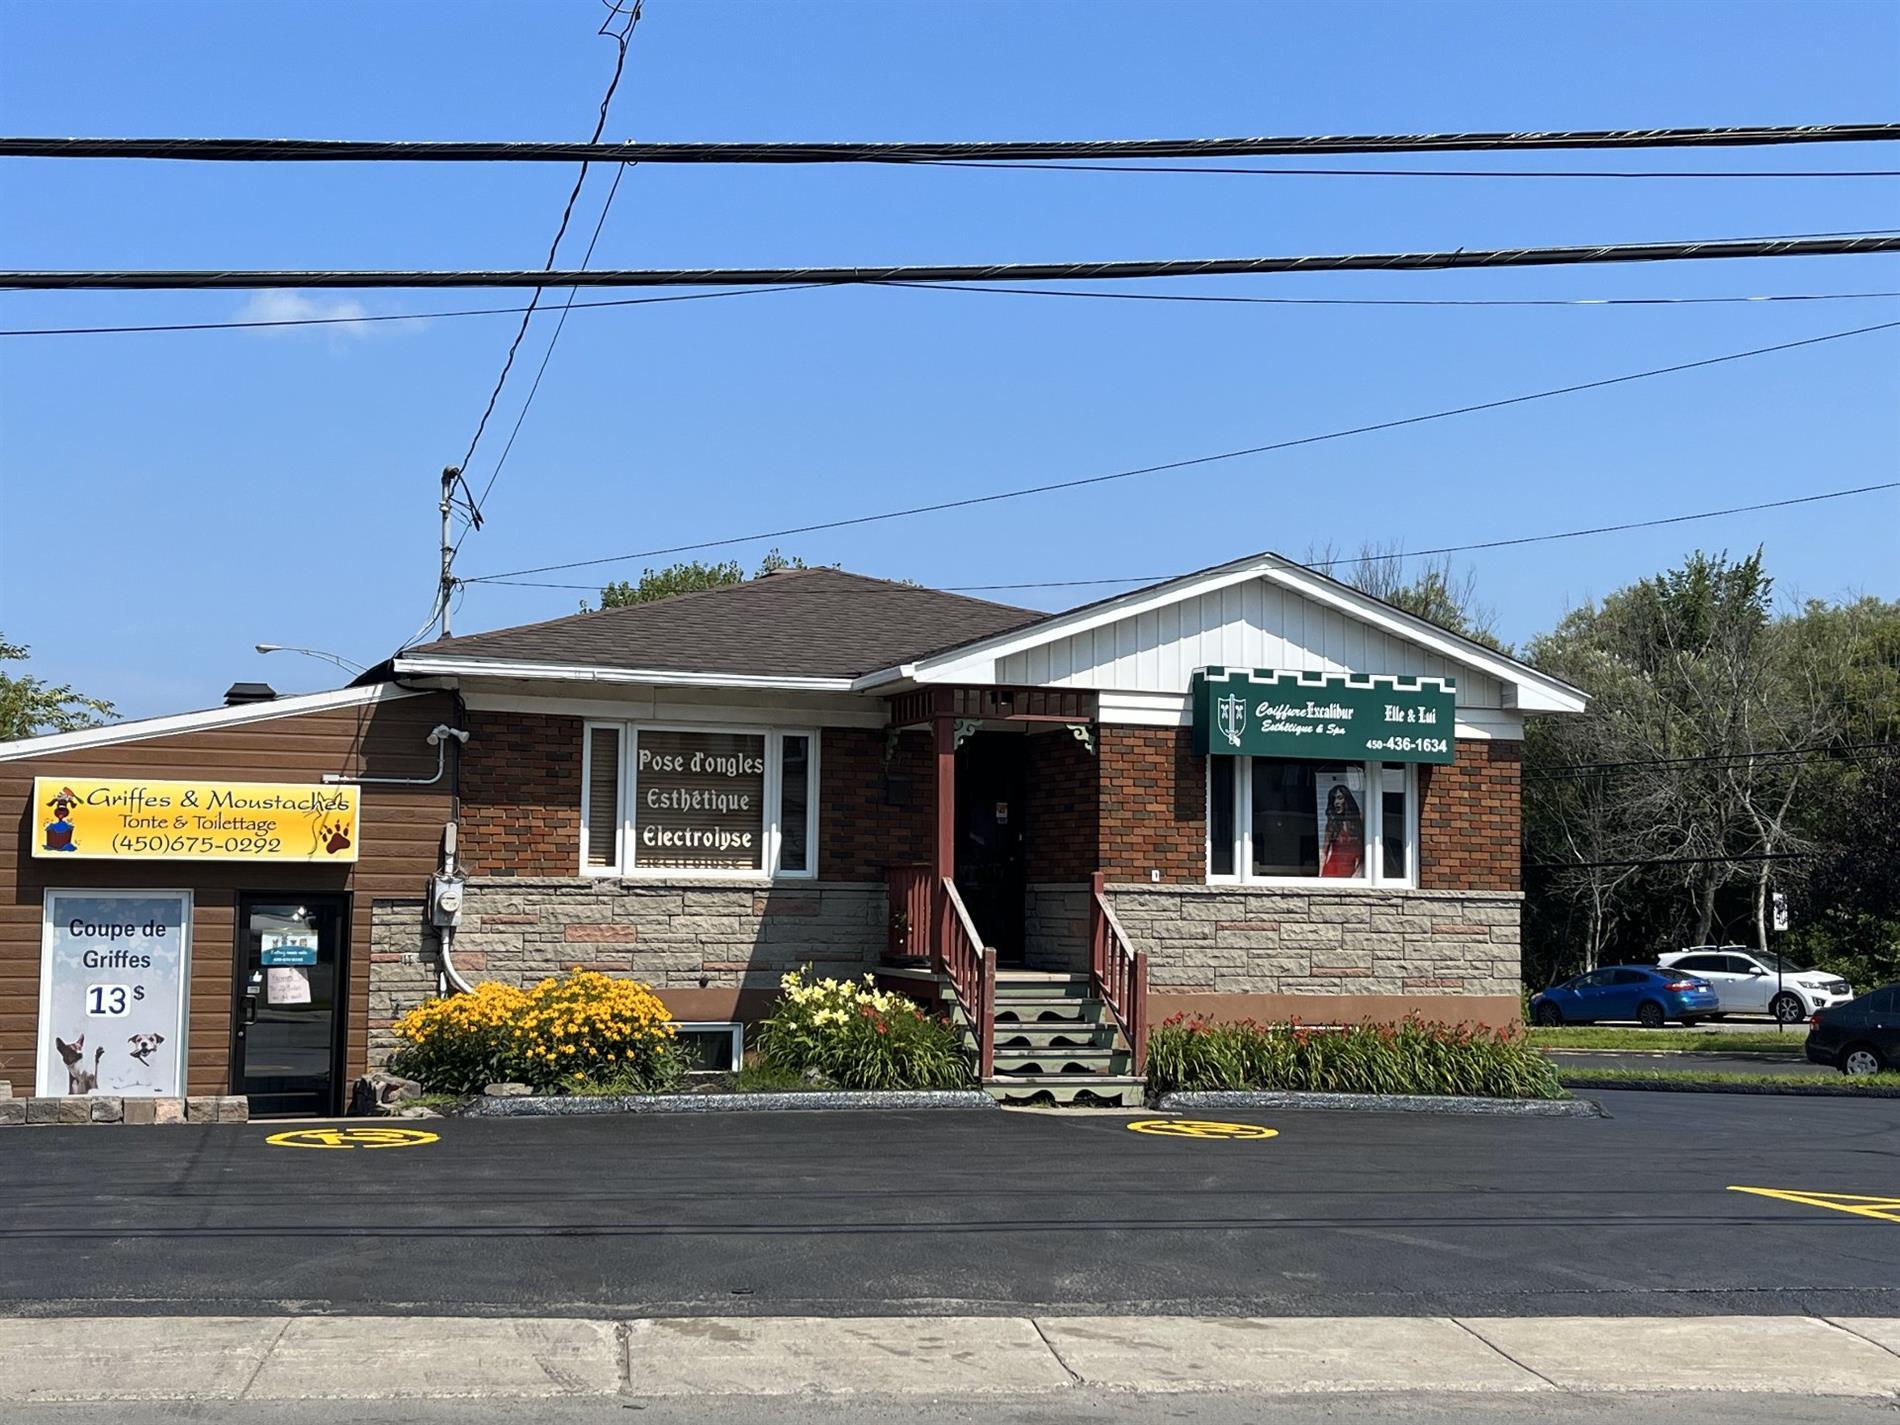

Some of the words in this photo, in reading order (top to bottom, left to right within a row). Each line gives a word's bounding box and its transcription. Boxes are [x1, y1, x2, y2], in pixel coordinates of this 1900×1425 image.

[1255, 701, 1306, 720] Coiffure
[1306, 701, 1354, 720] Excalibur
[1384, 704, 1405, 722] Elle
[1407, 708, 1416, 723] &
[1417, 706, 1436, 724] Lui
[1315, 723, 1324, 733] &
[1326, 723, 1346, 736] Spa
[1366, 736, 1448, 753] 450-436-1634
[639, 749, 684, 771] Pose
[690, 751, 763, 777] d'ongles
[87, 787, 171, 813] Griffes
[180, 790, 199, 808] &
[207, 790, 350, 811] Moustaches
[119, 814, 168, 829] Tonte
[173, 815, 188, 828] &
[193, 812, 277, 837] Toilettage
[112, 833, 281, 854] (450)675-0292
[643, 825, 752, 850] Electrolyse
[69, 918, 136, 941] Coupe
[142, 919, 166, 938] de
[82, 949, 151, 969] Griffes
